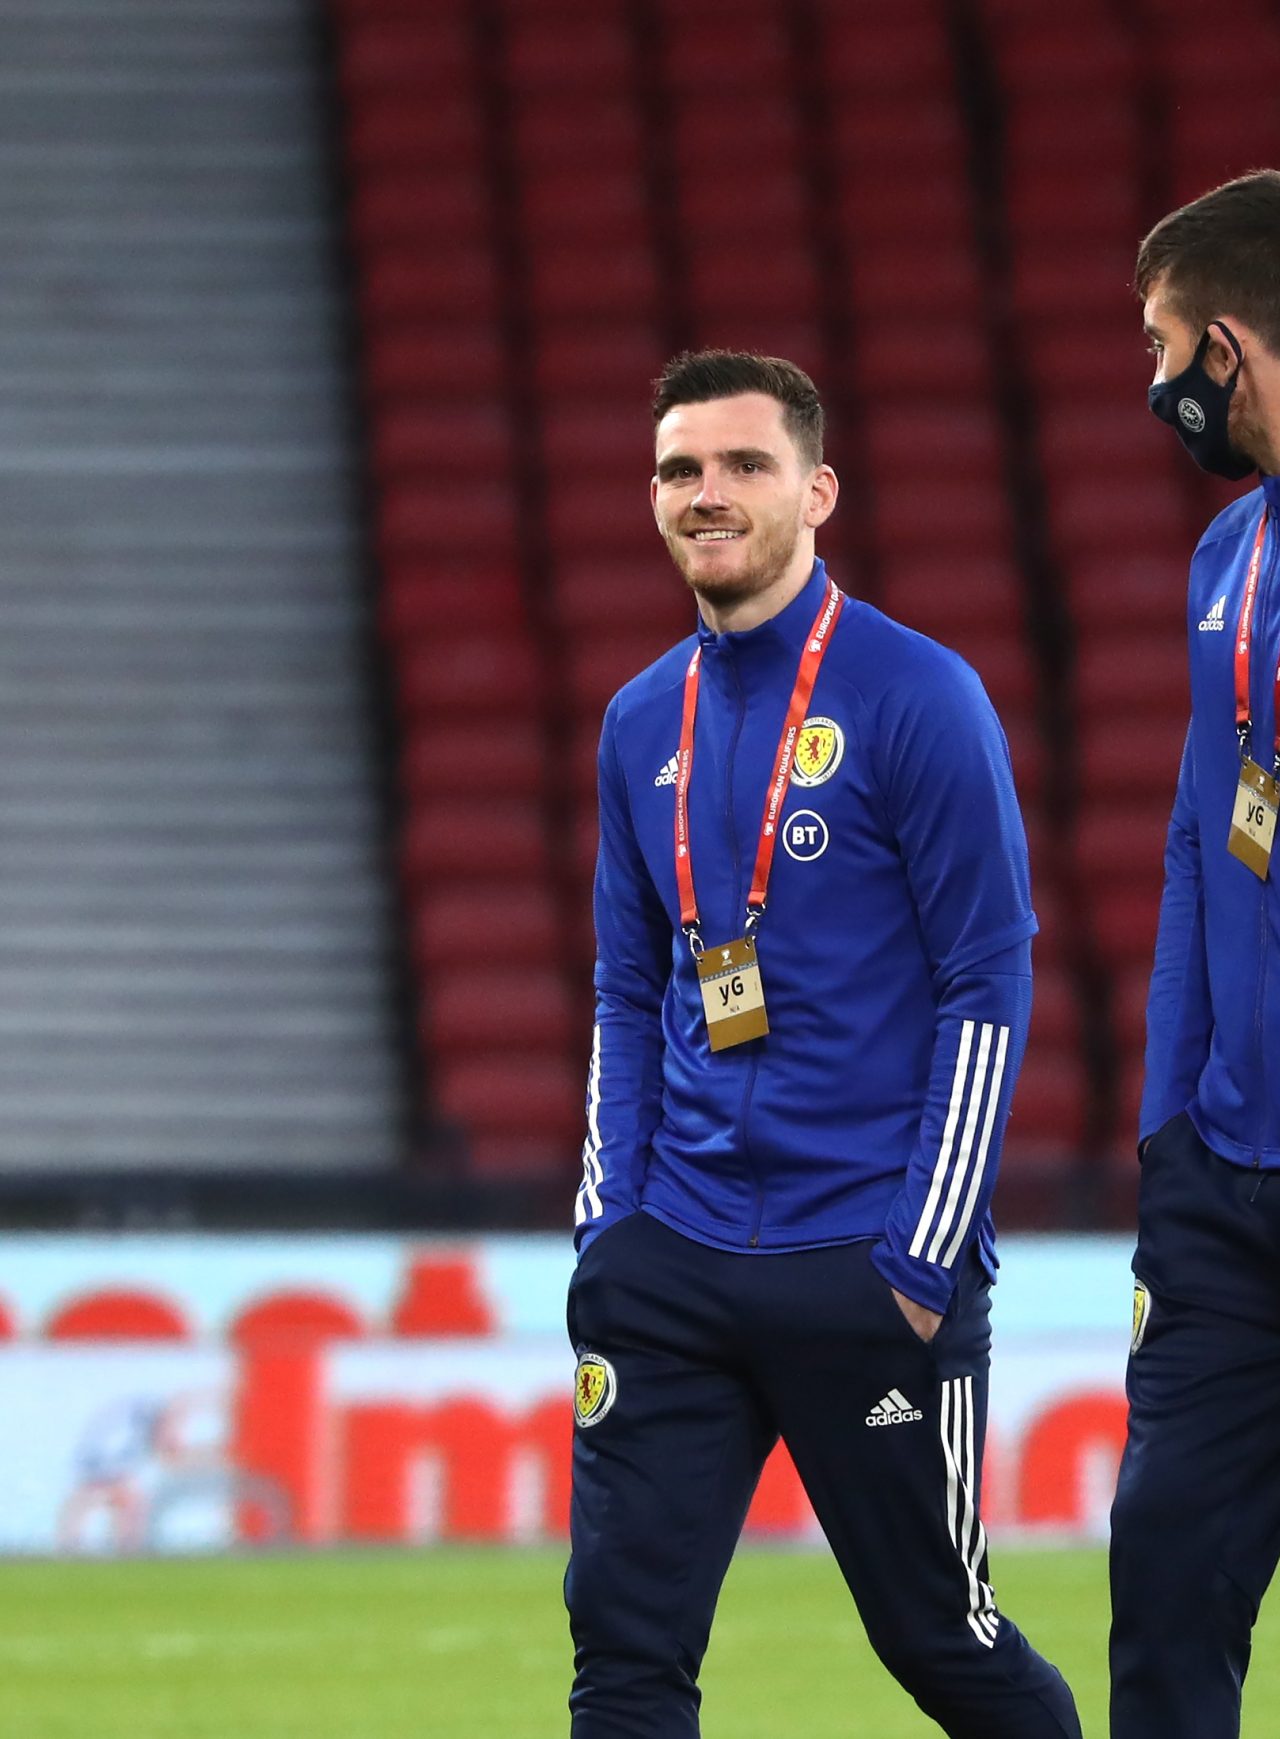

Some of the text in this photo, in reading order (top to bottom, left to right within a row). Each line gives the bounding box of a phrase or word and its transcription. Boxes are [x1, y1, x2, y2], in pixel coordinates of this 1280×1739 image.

[816, 599, 837, 639] EUROPEAN
[768, 726, 797, 820] EUROPEAN QUALIFIERS
[677, 796, 685, 841] EUROPEAN
[1246, 801, 1264, 826] yG
[792, 826, 818, 845] BT
[719, 975, 744, 1006] yG
[865, 1409, 923, 1427] adidas
